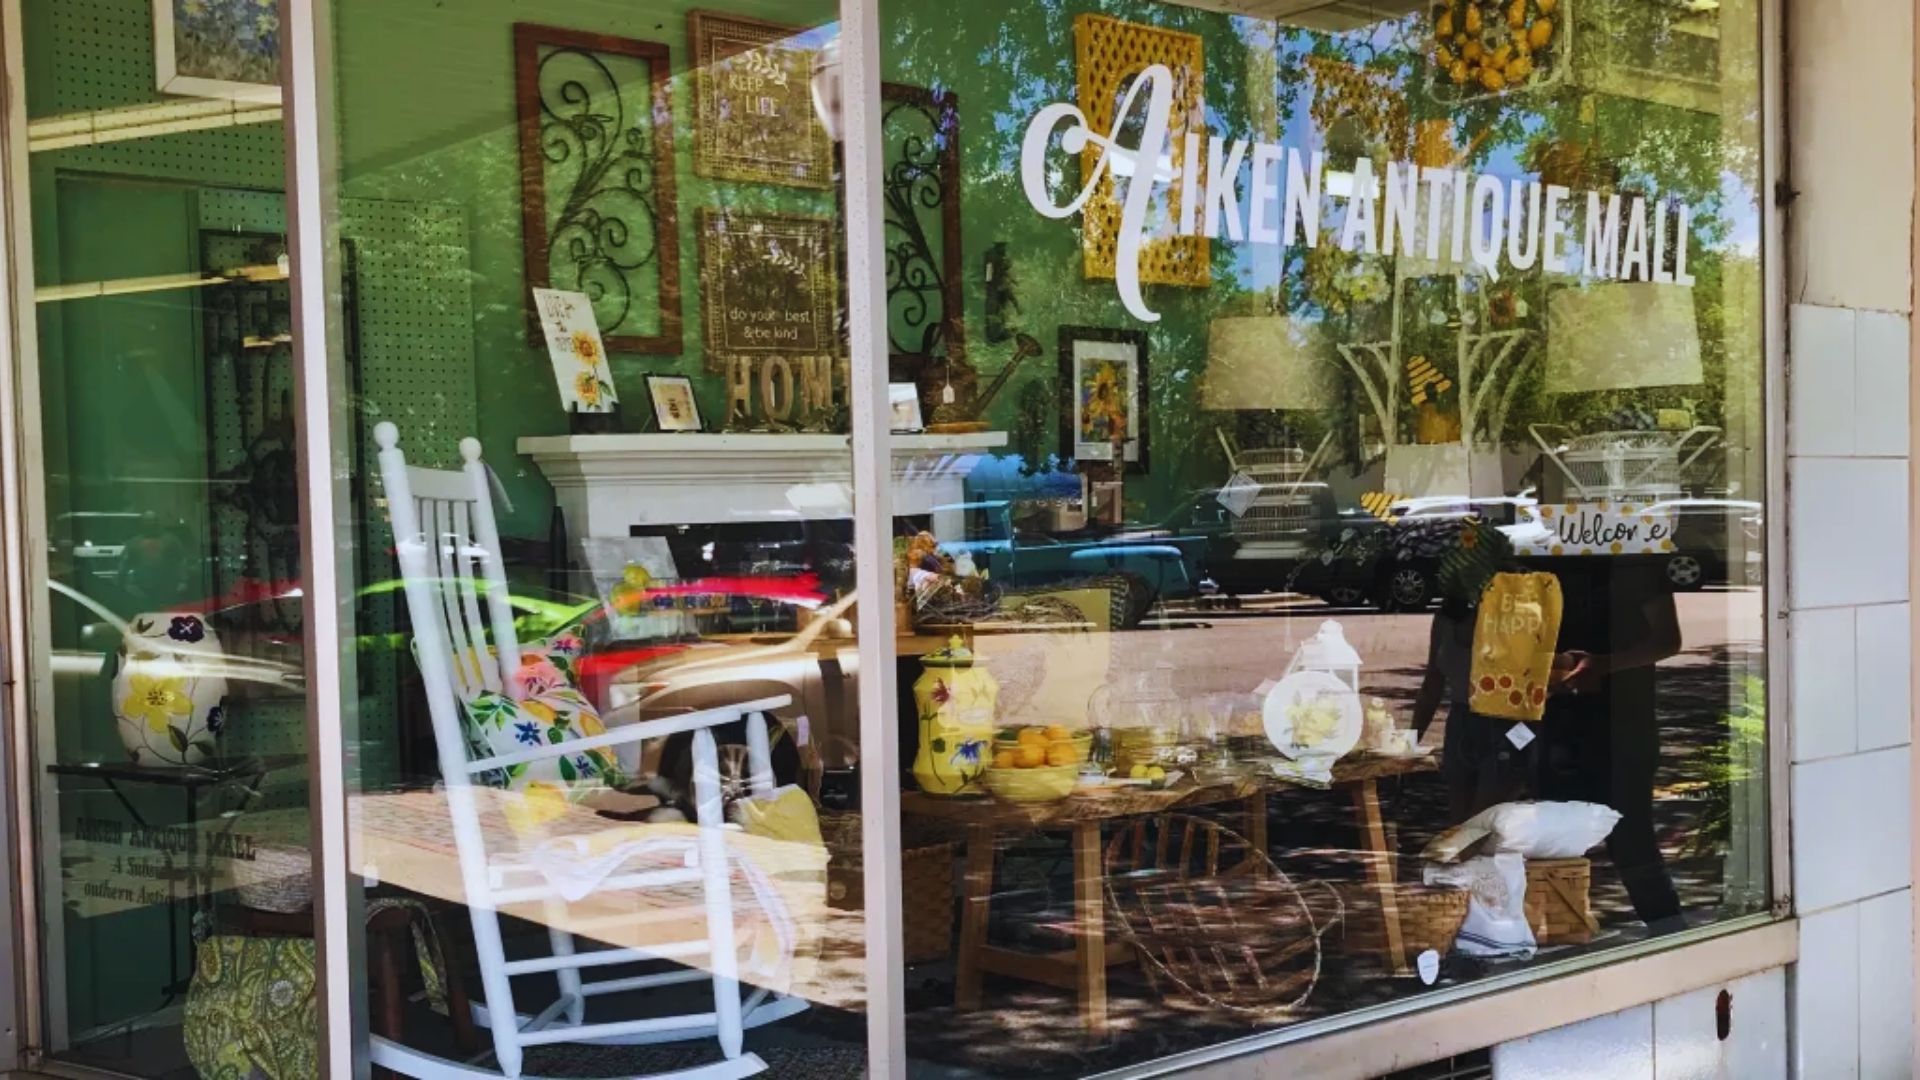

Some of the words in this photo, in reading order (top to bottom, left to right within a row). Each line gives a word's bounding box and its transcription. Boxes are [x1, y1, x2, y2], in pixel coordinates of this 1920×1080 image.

[728, 73, 764, 93] KEEP
[1021, 64, 1323, 322] AIKEN
[1340, 157, 1570, 283] ANTIQUE
[1583, 190, 1696, 287] MALL
[729, 306, 747, 321] do
[785, 308, 811, 323] best
[774, 326, 798, 340] kind
